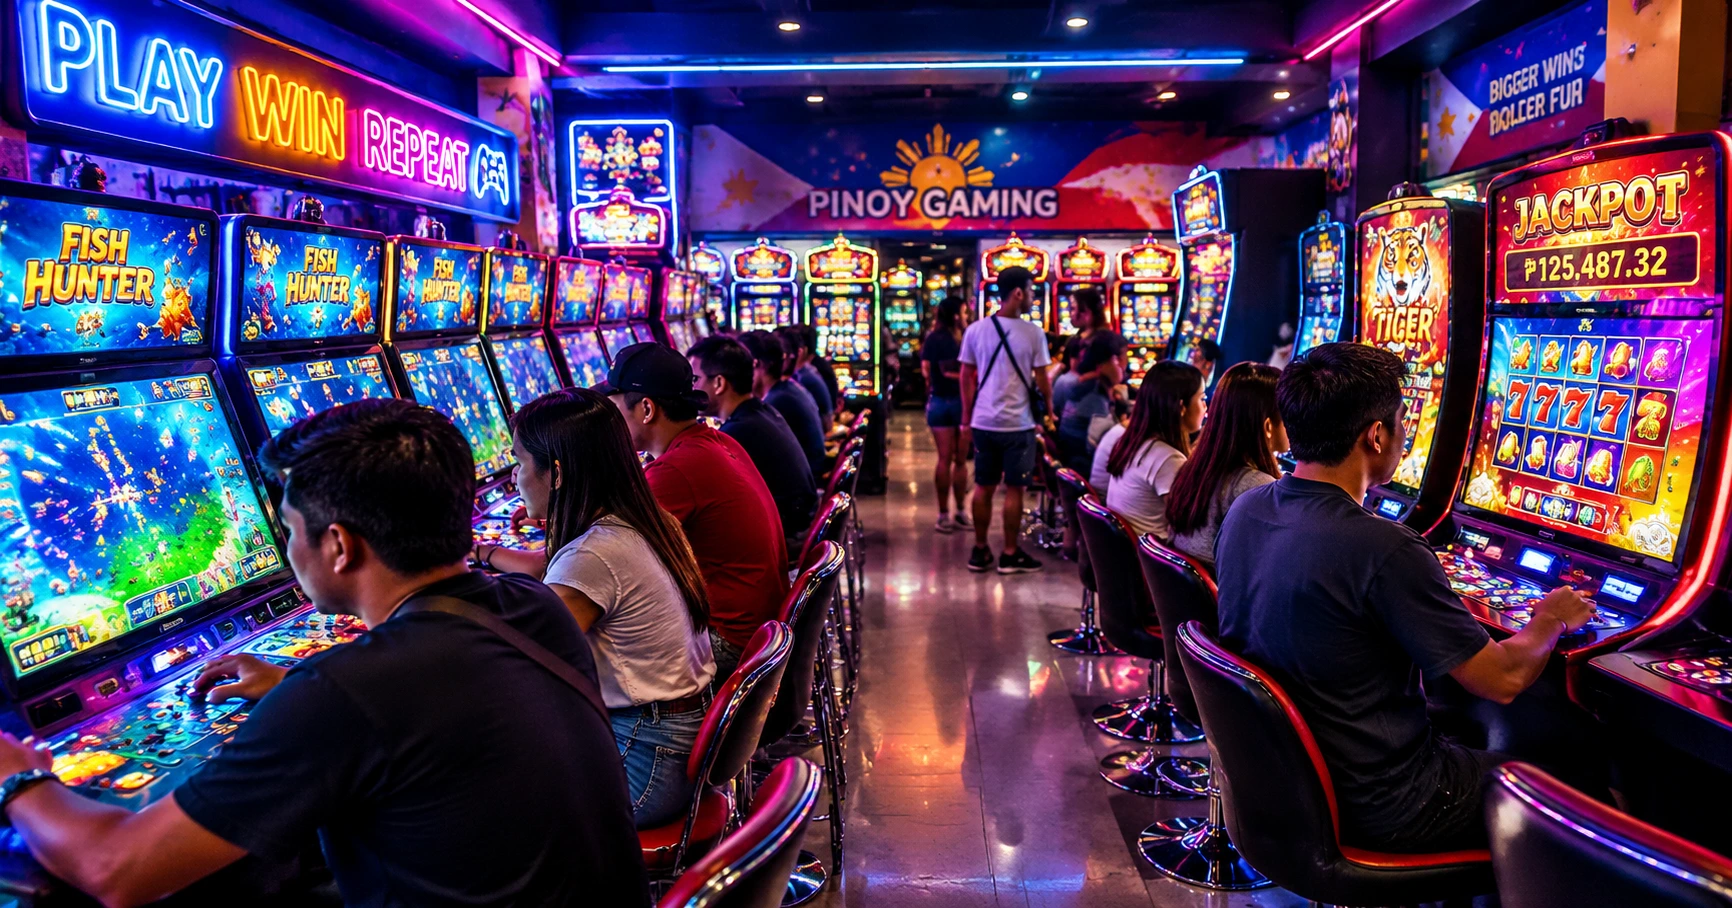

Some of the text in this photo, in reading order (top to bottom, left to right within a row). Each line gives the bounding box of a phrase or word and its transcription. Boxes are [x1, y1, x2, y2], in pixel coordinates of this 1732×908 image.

[1489, 43, 1587, 105] BIGGER WINS
[38, 0, 470, 193] PLAY WIN REPEAT
[809, 188, 1059, 219] PINOY GAMING
[1514, 170, 1689, 245] JACKPOT
[59, 222, 131, 265] FISH
[303, 245, 339, 274] FISH
[22, 259, 155, 311] HUNTER
[285, 271, 351, 308] HUNTER
[1372, 306, 1434, 343] TIGER
